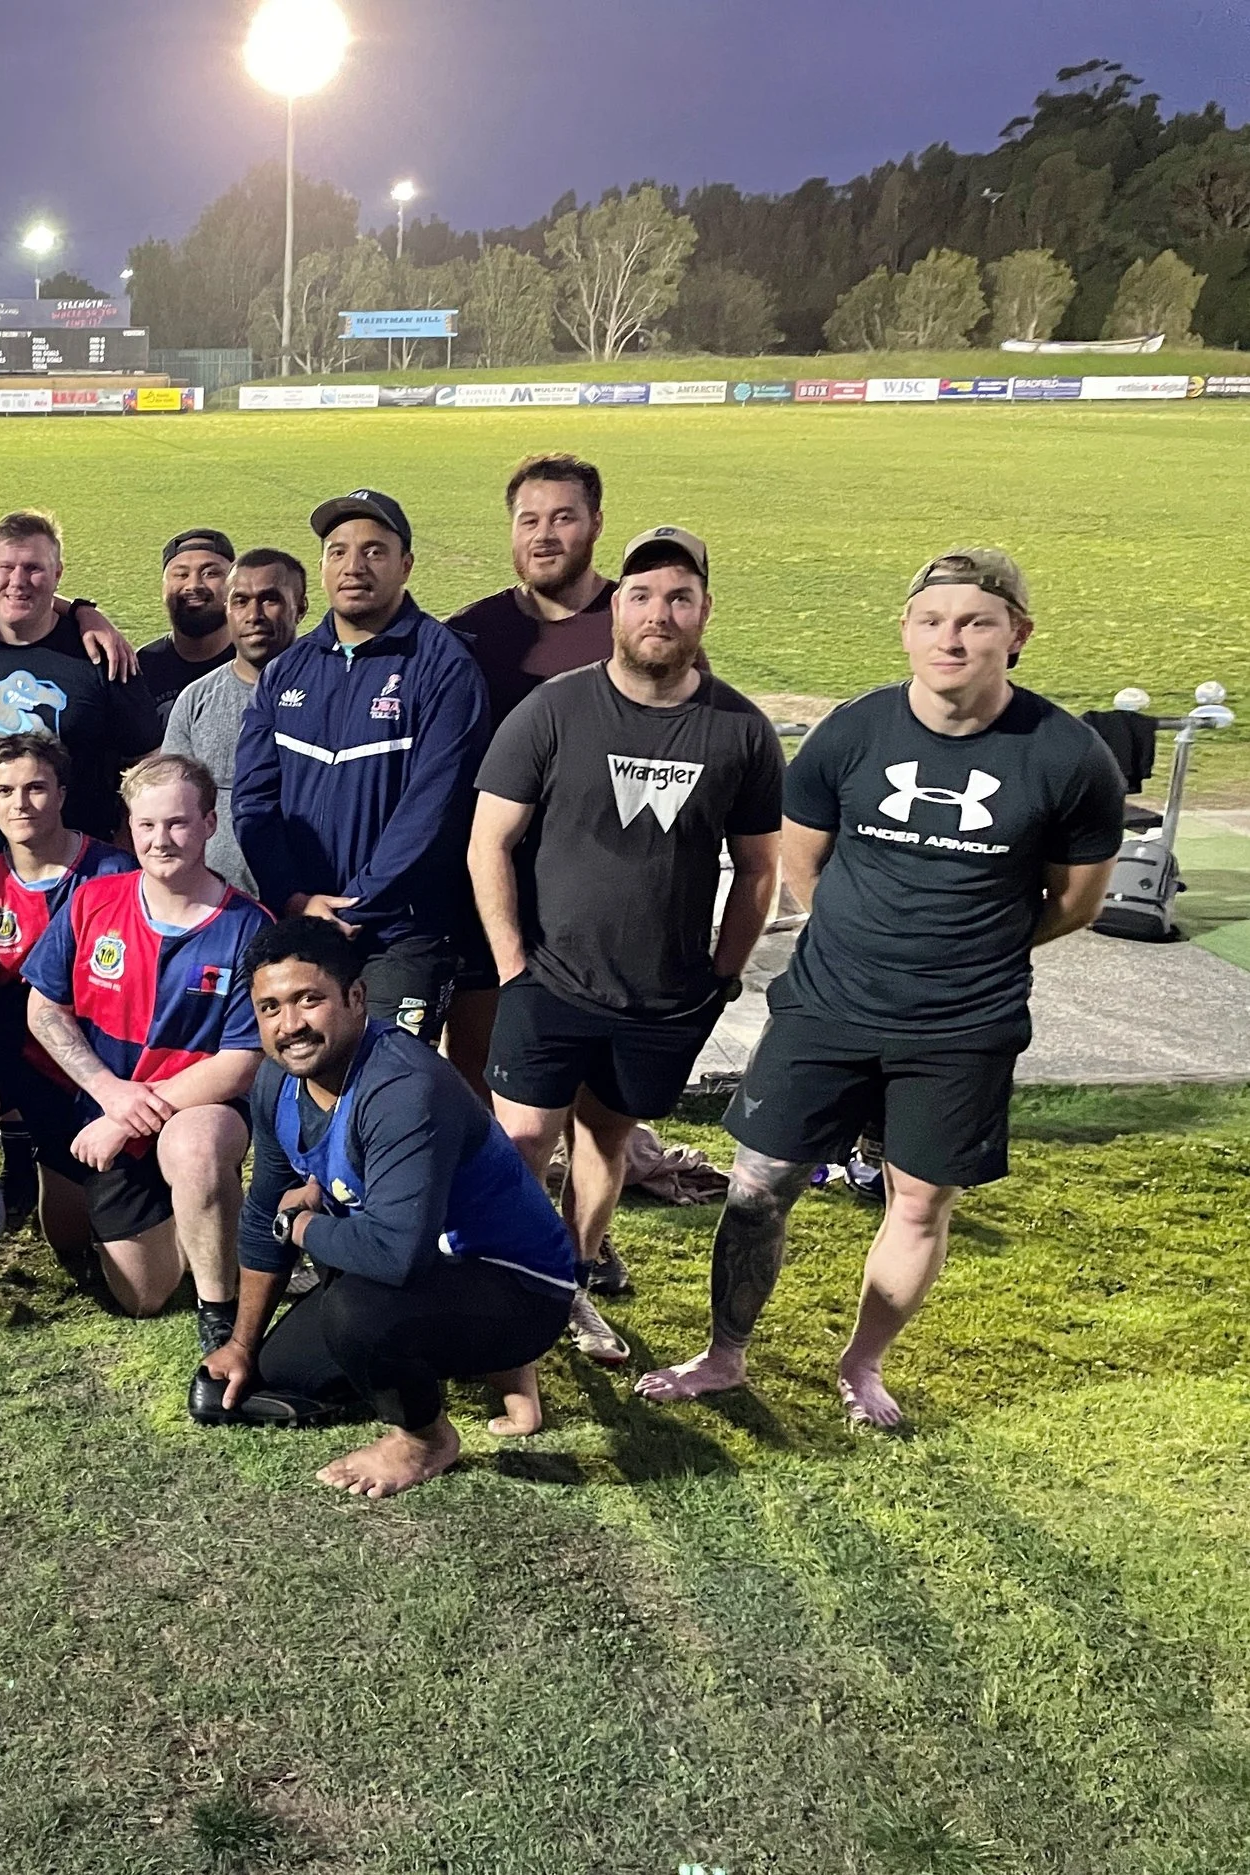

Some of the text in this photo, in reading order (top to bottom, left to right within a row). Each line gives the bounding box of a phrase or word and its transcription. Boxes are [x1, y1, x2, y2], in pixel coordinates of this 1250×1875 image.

[800, 385, 828, 397] BRIX
[883, 381, 925, 394] WJSC
[613, 758, 696, 790] Wrangler
[857, 824, 1010, 854] UNDER ARMOUR
